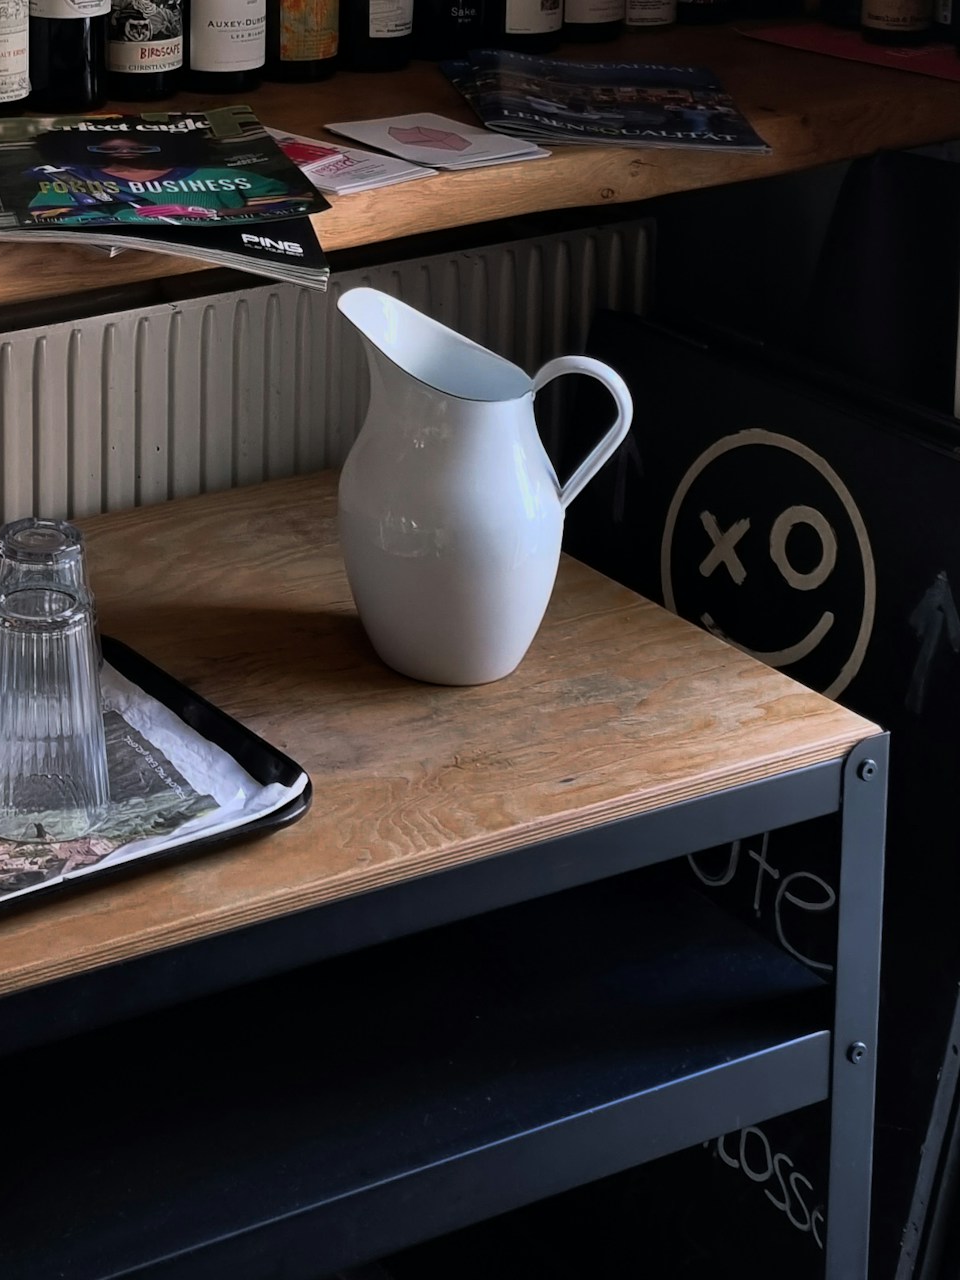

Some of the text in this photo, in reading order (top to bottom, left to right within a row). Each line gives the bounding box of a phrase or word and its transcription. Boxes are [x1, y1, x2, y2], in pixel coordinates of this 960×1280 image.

[451, 6, 477, 17] Sake
[139, 43, 181, 60] BIRDSCAPE
[500, 108, 739, 144] LEBENSQUALITÄT
[40, 176, 253, 195] FOKUS BUSINESS
[240, 232, 304, 253] PING
